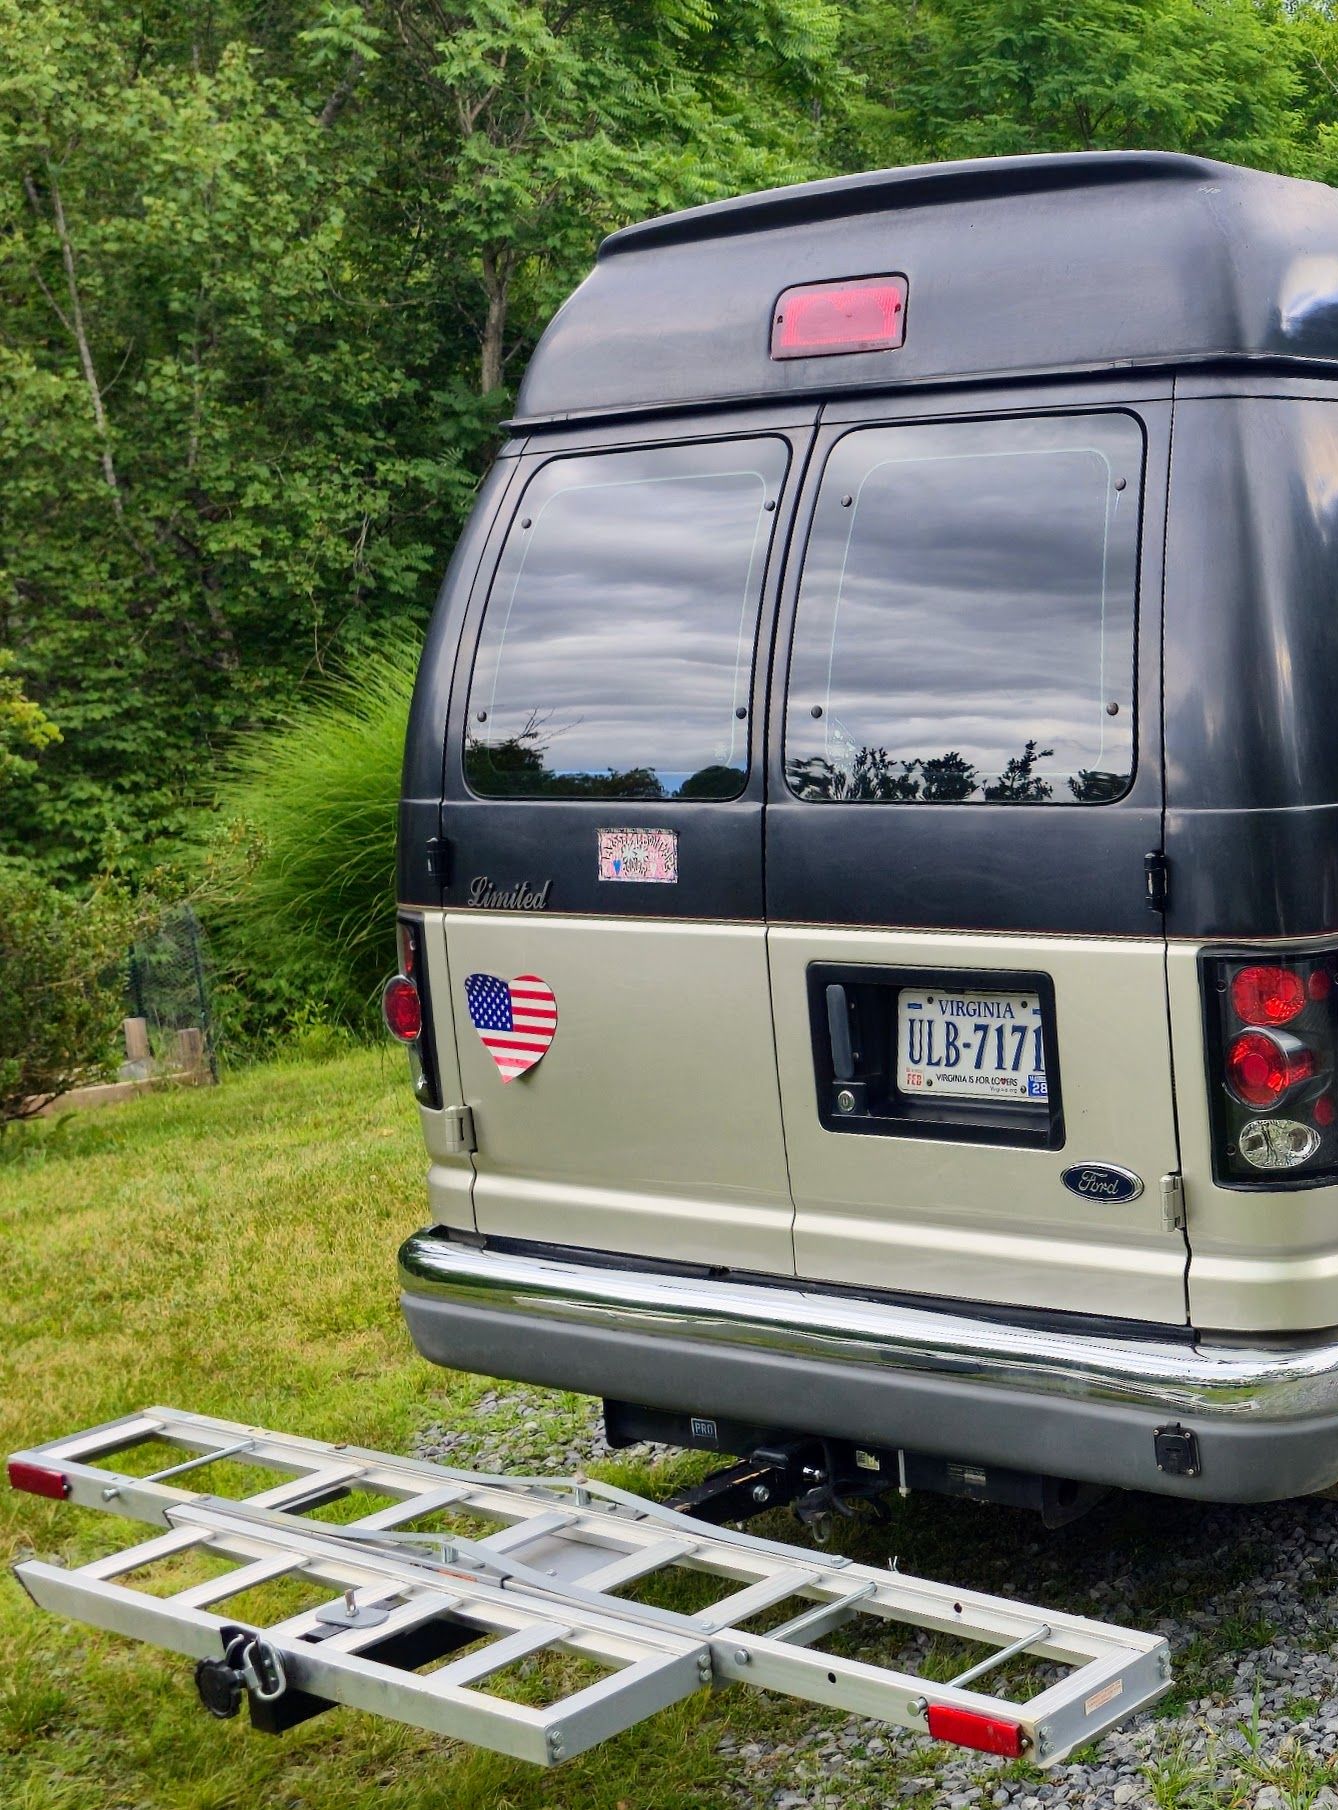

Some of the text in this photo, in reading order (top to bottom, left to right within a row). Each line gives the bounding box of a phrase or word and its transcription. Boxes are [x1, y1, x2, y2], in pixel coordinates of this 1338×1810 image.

[467, 876, 552, 910] Limited
[938, 999, 1015, 1019] VIRGINIA
[907, 1018, 1045, 1073] ULB-7171
[935, 1073, 967, 1083] VIRGINIA
[968, 1074, 974, 1084] IS
[975, 1075, 990, 1085] FOR
[1032, 1082, 1048, 1094] 28
[1078, 1170, 1119, 1195] Ford
[694, 1422, 713, 1435] PRO
